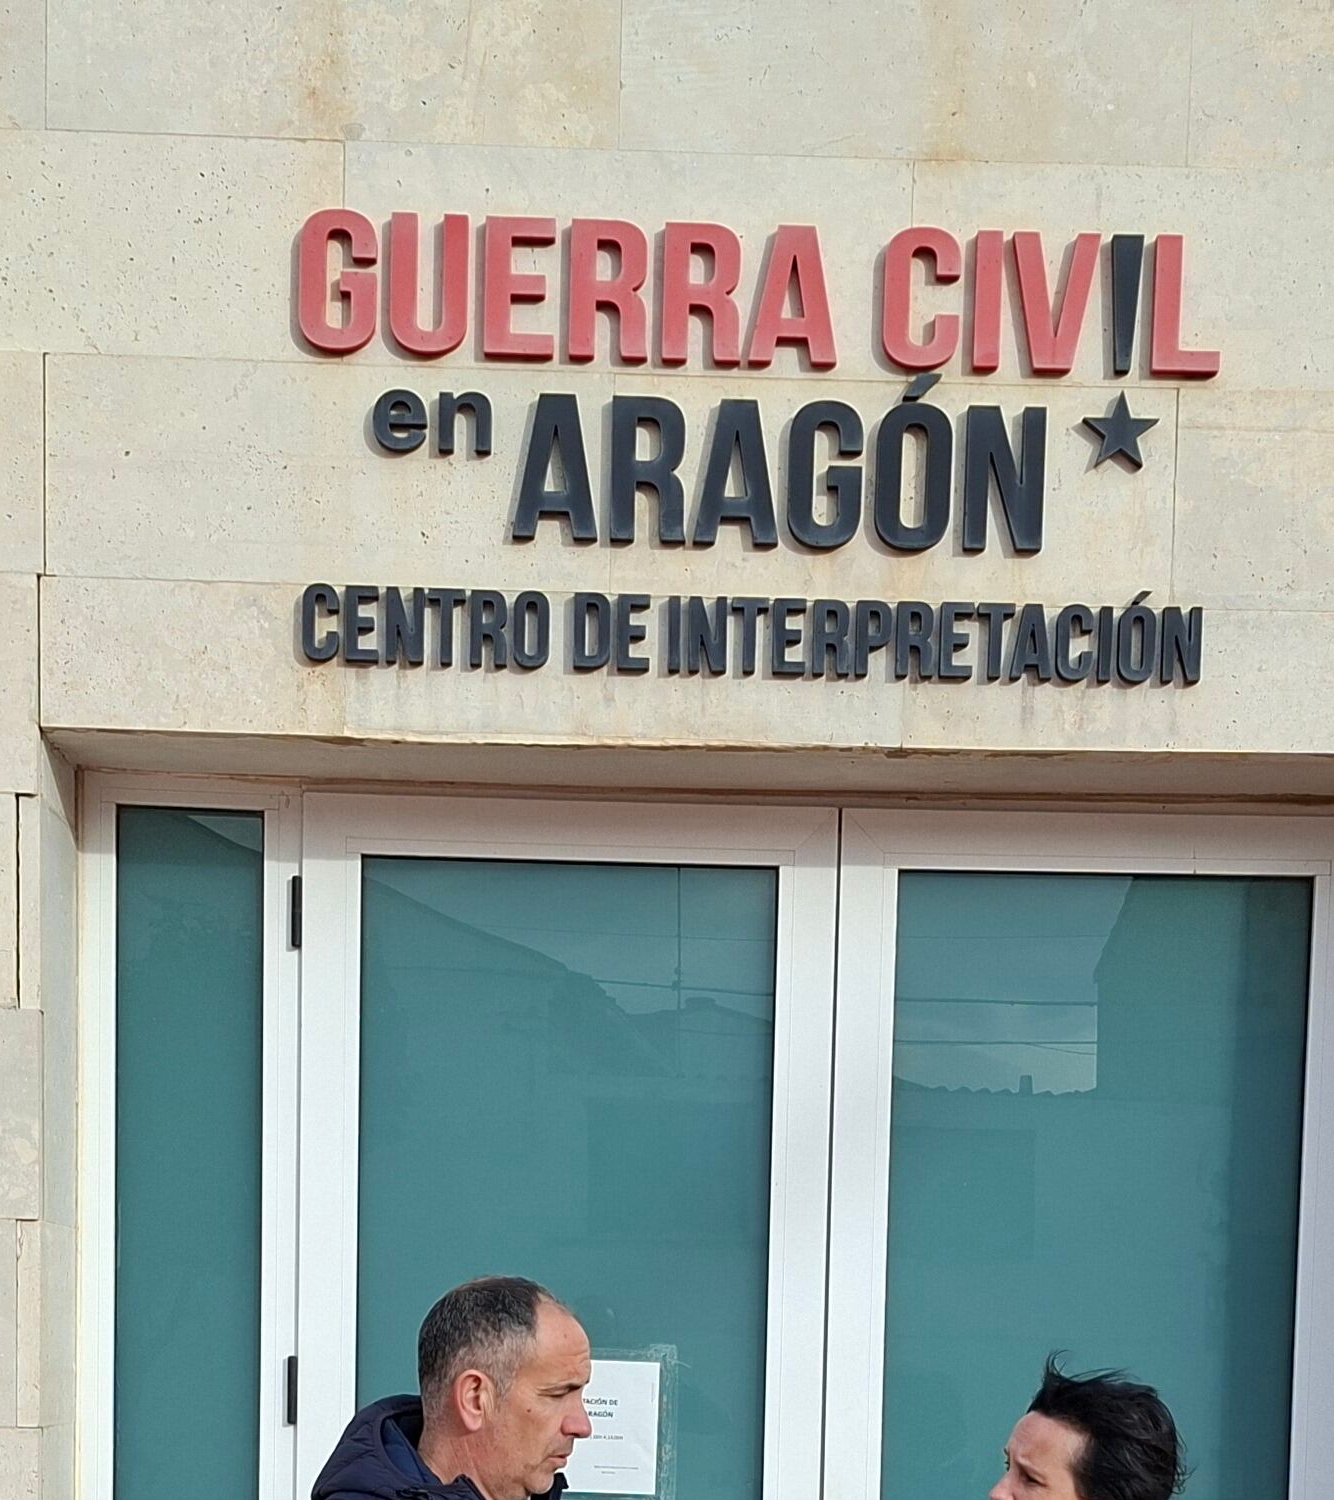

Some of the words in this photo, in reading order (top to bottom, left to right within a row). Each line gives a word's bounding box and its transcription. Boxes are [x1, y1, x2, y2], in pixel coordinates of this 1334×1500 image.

[298, 208, 837, 370] GUERRA
[880, 227, 1221, 379] CIVIL
[372, 388, 493, 457] en
[511, 373, 1048, 556] ARAGÓN
[300, 582, 550, 672] CENTRO
[573, 592, 651, 677] DE
[668, 591, 1203, 686] INTERPRETACIÓN
